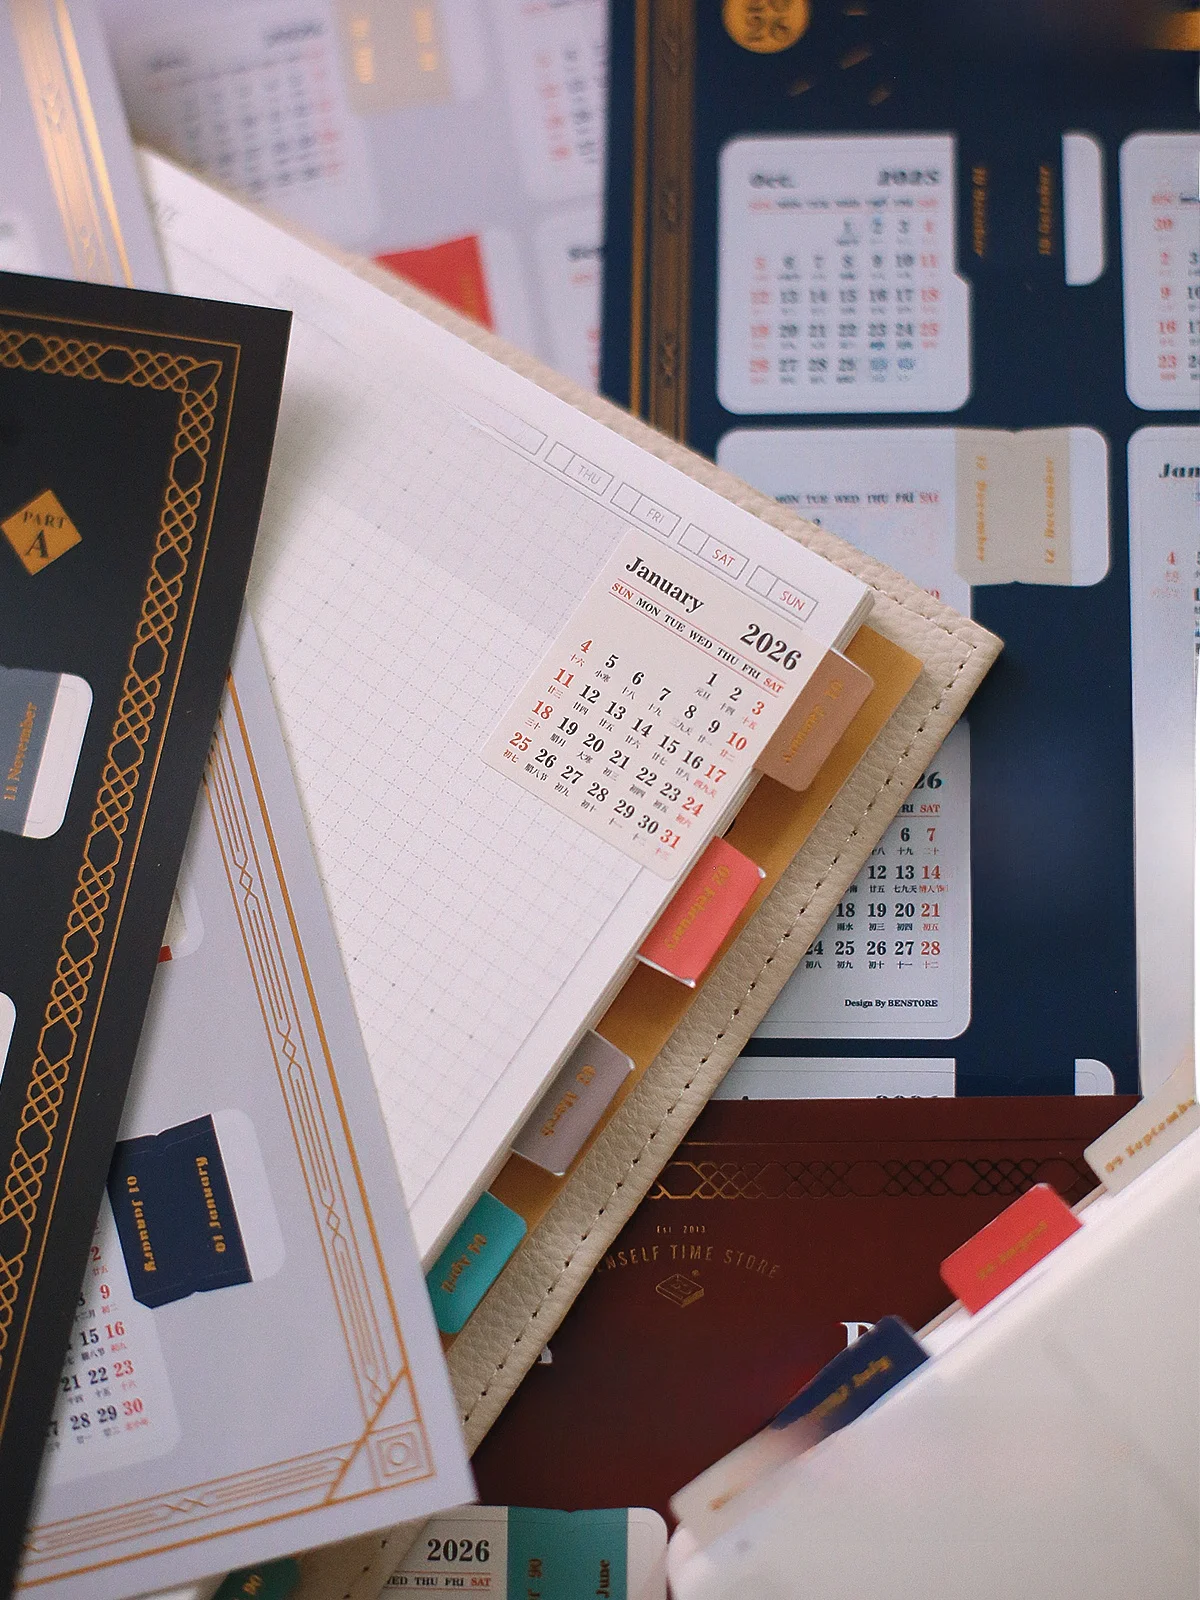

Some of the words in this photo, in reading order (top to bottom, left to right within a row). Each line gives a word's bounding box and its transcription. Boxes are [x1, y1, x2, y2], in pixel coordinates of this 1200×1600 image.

[576, 464, 603, 486] THU
[895, 491, 915, 503] FRI
[23, 511, 66, 529] PART
[645, 507, 663, 525] FRI
[24, 529, 49, 559] A
[712, 548, 736, 568] SAT
[1167, 551, 1176, 566] 4
[625, 556, 704, 614] January
[779, 589, 806, 612] SUN
[611, 582, 635, 600] SUN
[636, 597, 661, 617] MON
[664, 614, 686, 633] TUE
[688, 629, 713, 650] WED
[717, 647, 740, 666] THU
[741, 663, 761, 680] FRI
[763, 677, 785, 694] SAT
[739, 622, 802, 671] 2026
[570, 653, 585, 668] 十六
[594, 669, 611, 683] 小寒
[621, 686, 636, 700] 十八
[648, 702, 662, 717] 十九
[580, 638, 593, 654] 4
[605, 654, 619, 669] 5
[632, 671, 645, 686] 6
[658, 687, 672, 702] 7
[684, 704, 698, 720] 8
[707, 719, 721, 734] 9
[726, 731, 748, 751] 10
[706, 671, 718, 688] 1
[729, 686, 742, 702] 2
[751, 700, 765, 716] 3
[720, 702, 736, 716] 十四
[547, 684, 564, 700] 廿三
[572, 701, 589, 716] 廿四
[598, 717, 616, 733] 廿五
[624, 734, 641, 750] 廿六
[651, 751, 668, 767] 廿七
[675, 767, 691, 782] 廿八
[553, 667, 575, 689] 11
[578, 684, 601, 704] 12
[604, 700, 627, 721] 13
[631, 717, 653, 738] 14
[657, 734, 681, 754] 15
[682, 750, 704, 770] 16
[704, 764, 727, 784] 17
[7, 702, 37, 781] November
[524, 716, 541, 731] 三十
[576, 750, 594, 764] 大寒
[602, 767, 620, 782] 初三
[629, 783, 647, 798] 初四
[531, 700, 554, 720] 18
[556, 716, 579, 736] 19
[582, 732, 605, 753] 20
[608, 749, 631, 771] 21
[635, 766, 658, 787] 22
[659, 782, 682, 802] 23
[681, 796, 704, 817] 24
[502, 748, 520, 764] 初七
[554, 782, 570, 798] 初九
[580, 799, 597, 813] 初十
[508, 731, 533, 752] 25
[534, 748, 558, 769] 26
[560, 764, 584, 785] 27
[586, 781, 610, 802] 28
[613, 798, 636, 819] 29
[637, 814, 659, 835] 30
[659, 828, 681, 850] 31
[913, 771, 942, 789] 26
[3, 785, 17, 801] 11
[901, 804, 914, 813] RI
[920, 804, 940, 813] SAT
[900, 827, 911, 842] 6
[926, 827, 937, 842] 7
[897, 847, 914, 856] 十九
[867, 865, 887, 880] 12
[895, 865, 915, 880] 13
[921, 864, 941, 880] 14
[869, 885, 885, 893] 廿五
[893, 885, 917, 893] 七九天
[664, 886, 716, 950] February
[835, 902, 856, 917] 18
[867, 902, 887, 918] 19
[894, 902, 915, 918] 20
[921, 902, 940, 918] 21
[836, 922, 854, 931] 雨水
[868, 922, 885, 931] 初三
[896, 922, 913, 931] 初四
[923, 923, 939, 931] 初五
[805, 940, 824, 955] 24
[834, 940, 856, 956] 25
[866, 940, 887, 956] 26
[894, 940, 915, 956] 27
[920, 940, 941, 956] 28
[805, 960, 822, 969] 初八
[836, 960, 853, 969] 初九
[868, 960, 885, 969] 初十
[896, 961, 913, 969] 十一
[923, 961, 939, 969] 十二
[844, 999, 873, 1008] Design
[874, 999, 886, 1008] By
[888, 999, 938, 1007] BENSTORE
[541, 1090, 578, 1137] March
[126, 1175, 140, 1193] 01
[195, 1156, 222, 1229] January
[131, 1199, 157, 1272] January
[683, 1225, 706, 1233] 2013
[91, 1246, 101, 1261] 2
[212, 1234, 226, 1253] 01
[670, 1244, 714, 1261] TIME
[723, 1249, 781, 1279] STORE
[441, 1254, 471, 1294] April
[100, 1284, 111, 1300] 9
[80, 1327, 100, 1346] 15
[105, 1321, 125, 1339] 16
[60, 1374, 81, 1392] 21
[88, 1366, 108, 1385] 22
[113, 1360, 134, 1378] 23
[70, 1412, 91, 1431] 28
[97, 1405, 117, 1423] 29
[122, 1398, 143, 1416] 30
[427, 1538, 490, 1562] 2026
[414, 1577, 438, 1586] THU
[445, 1577, 464, 1586] FRI
[471, 1577, 491, 1586] SAT
[596, 1559, 611, 1599] June
